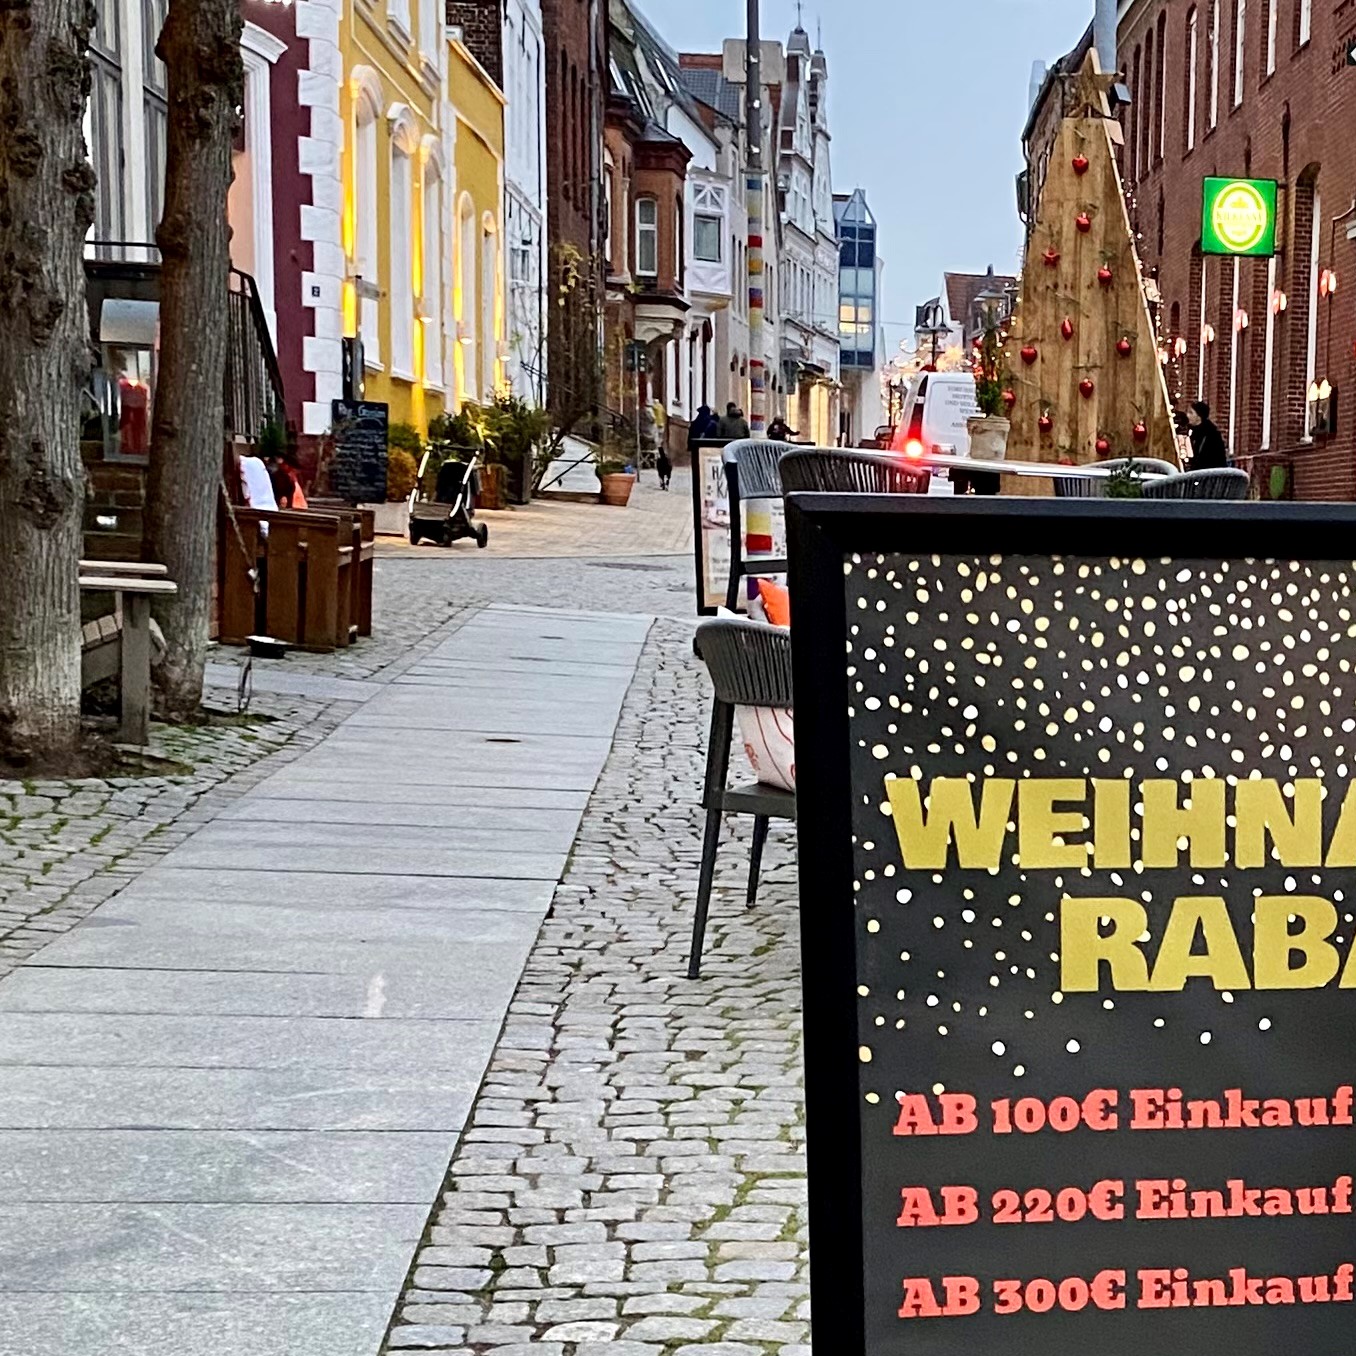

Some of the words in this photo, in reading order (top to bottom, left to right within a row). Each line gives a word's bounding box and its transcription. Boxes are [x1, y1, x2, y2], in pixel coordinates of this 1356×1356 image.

[893, 1093, 977, 1135] AB
[992, 1089, 1118, 1133] 100€
[1130, 1086, 1353, 1130] Einkauf
[897, 1185, 979, 1227] AB
[992, 1180, 1124, 1224] 220€
[1136, 1176, 1353, 1219] Einkauf
[899, 1276, 980, 1318] AB
[994, 1270, 1126, 1314] 300€
[1137, 1264, 1354, 1309] Einkauf
